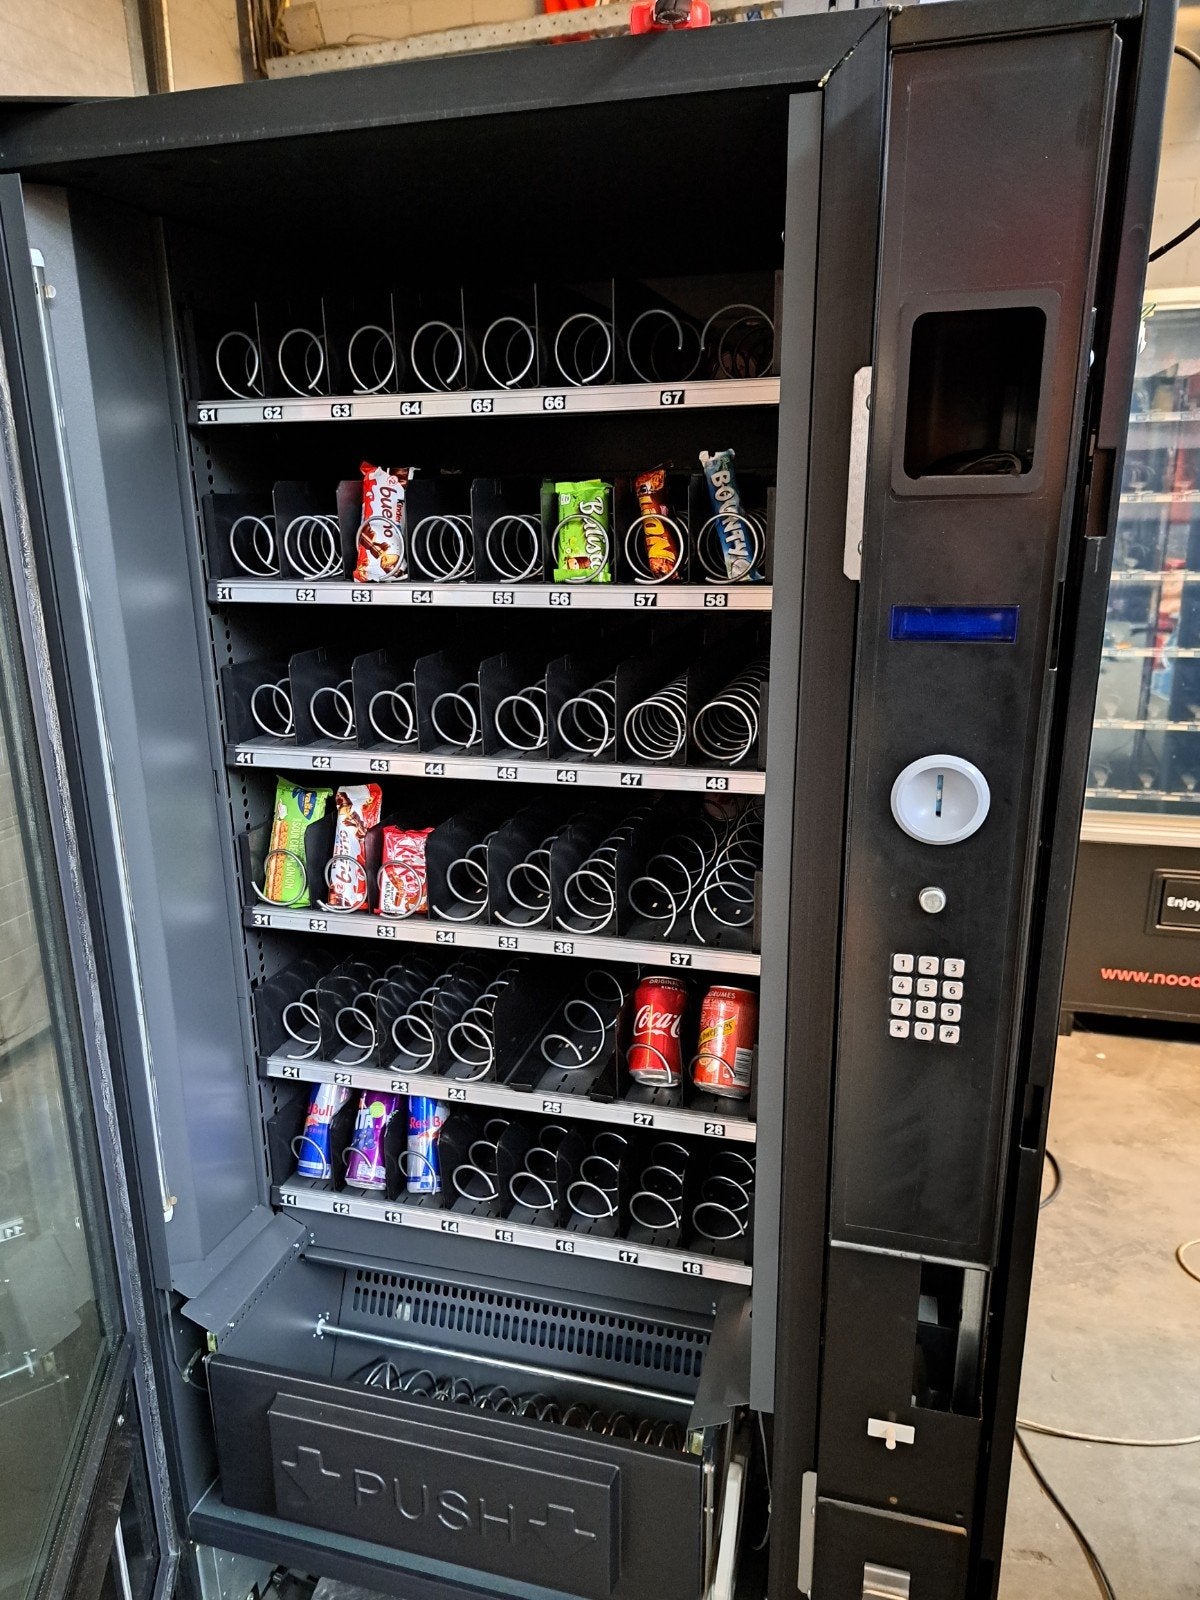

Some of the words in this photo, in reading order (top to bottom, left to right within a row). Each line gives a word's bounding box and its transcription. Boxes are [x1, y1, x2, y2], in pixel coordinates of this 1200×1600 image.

[200, 409, 216, 421] 61
[264, 407, 281, 419] 62
[332, 405, 350, 417] 63
[401, 402, 420, 415] 64
[472, 399, 492, 412] 65
[544, 396, 565, 410] 66
[661, 391, 683, 404] 67
[711, 470, 749, 556] BOUNTY
[217, 588, 231, 600] 51
[297, 589, 315, 601] 52
[352, 590, 371, 602] 53
[413, 591, 432, 603] 54
[494, 592, 513, 604] 55
[550, 593, 570, 605] 56
[635, 594, 656, 606] 57
[705, 594, 726, 606] 58
[236, 753, 252, 764] 41
[313, 757, 330, 768] 42
[371, 760, 388, 771] 43
[425, 764, 443, 775] 44
[498, 768, 516, 779] 45
[557, 771, 576, 782] 46
[621, 774, 641, 785] 47
[706, 778, 727, 789] 48
[290, 821, 301, 839] SOUR
[287, 839, 298, 863] CREM
[284, 866, 296, 889] ONION
[1166, 896, 1200, 912] Enjoy
[254, 915, 270, 925] 31
[310, 920, 327, 931] 32
[378, 926, 395, 937] 33
[436, 931, 454, 942] 34
[499, 937, 517, 948] 35
[555, 942, 573, 953] 36
[672, 954, 690, 965] 37
[1101, 967, 1200, 989] www.nood
[284, 1067, 299, 1077] 21
[335, 1074, 351, 1084] 22
[392, 1081, 408, 1092] 23
[449, 1089, 465, 1100] 24
[543, 1102, 561, 1113] 25
[634, 1114, 653, 1125] 27
[705, 1123, 724, 1135] 28
[281, 1195, 296, 1205] 11
[334, 1203, 350, 1214] 12
[386, 1212, 401, 1223] 13
[442, 1221, 458, 1232] 14
[496, 1230, 512, 1241] 15
[556, 1240, 573, 1252] 16
[620, 1251, 637, 1263] 17
[684, 1262, 701, 1274] 18
[354, 1468, 516, 1543] PUSH
